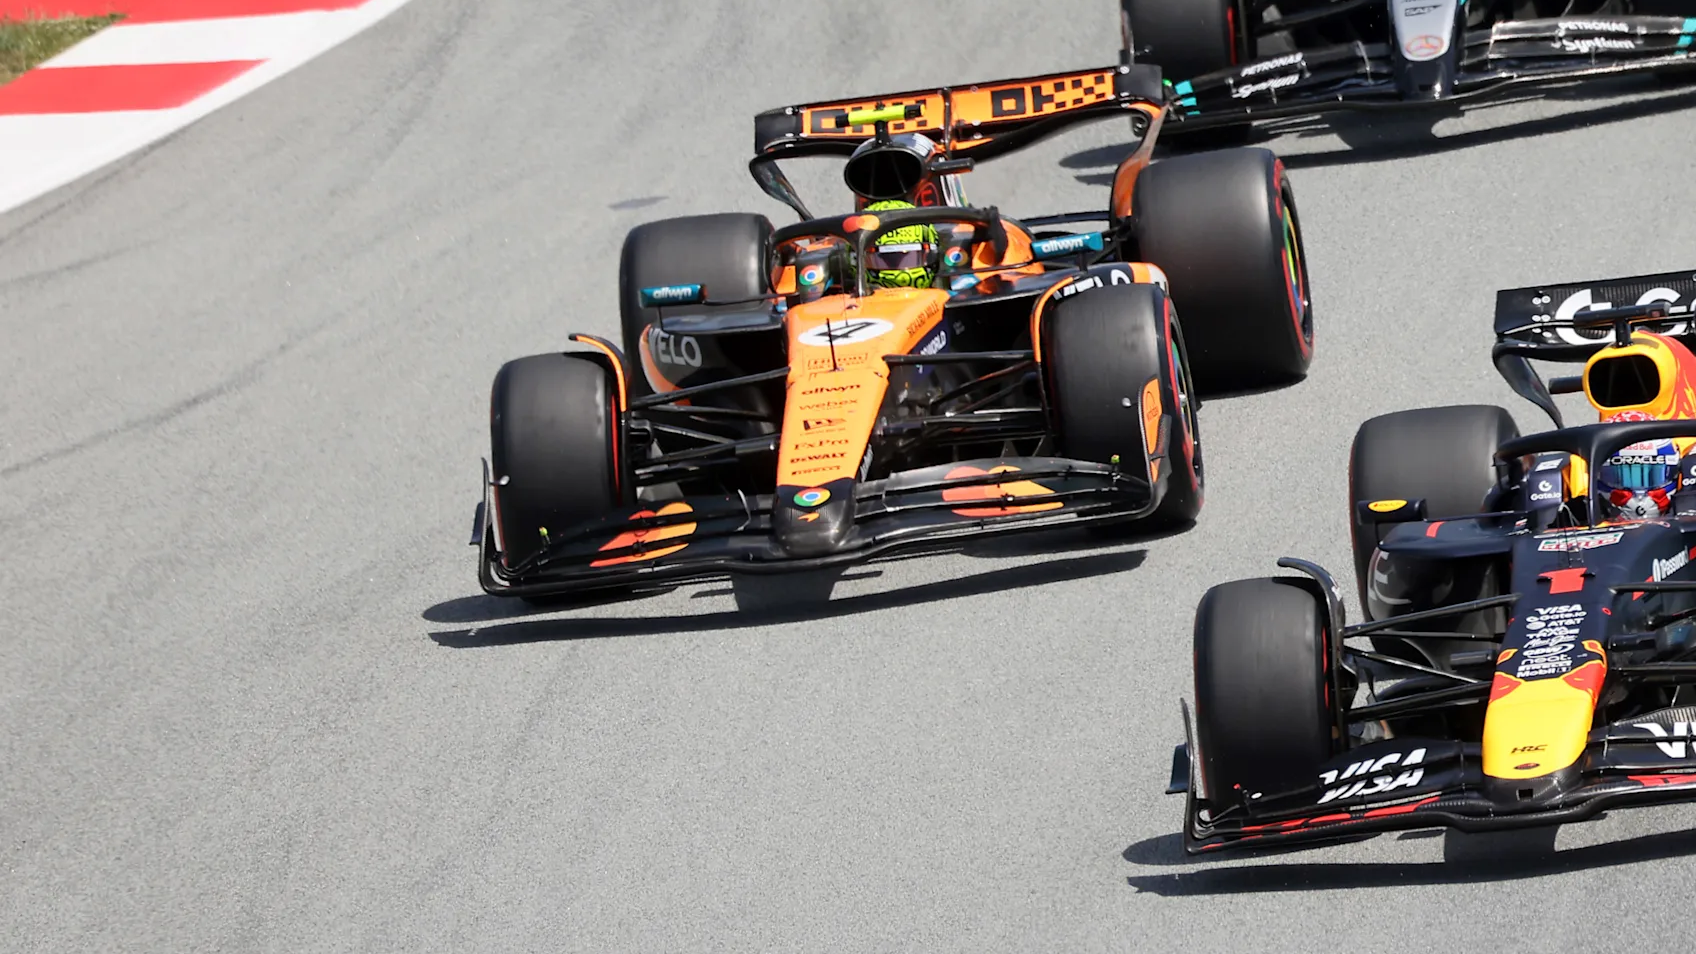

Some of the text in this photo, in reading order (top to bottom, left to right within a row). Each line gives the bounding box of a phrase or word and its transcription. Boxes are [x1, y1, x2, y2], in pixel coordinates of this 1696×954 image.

[1557, 21, 1630, 33] PETRONAS
[1240, 52, 1304, 77] PETRONAS
[1041, 238, 1085, 254] allwyn
[652, 286, 693, 301] allwyn
[800, 384, 861, 396] allwyn
[799, 398, 858, 411] webex
[794, 438, 850, 451] FxPro
[1639, 442, 1654, 451] Bull
[1611, 455, 1666, 465] ORACLE
[1530, 491, 1563, 502] Gate.io
[1538, 567, 1588, 595] 1
[1534, 603, 1583, 615] VISA
[1547, 617, 1585, 627] AT&T
[1516, 667, 1557, 678] Mobil
[1511, 744, 1548, 755] HRC
[1317, 747, 1427, 805] VISA
